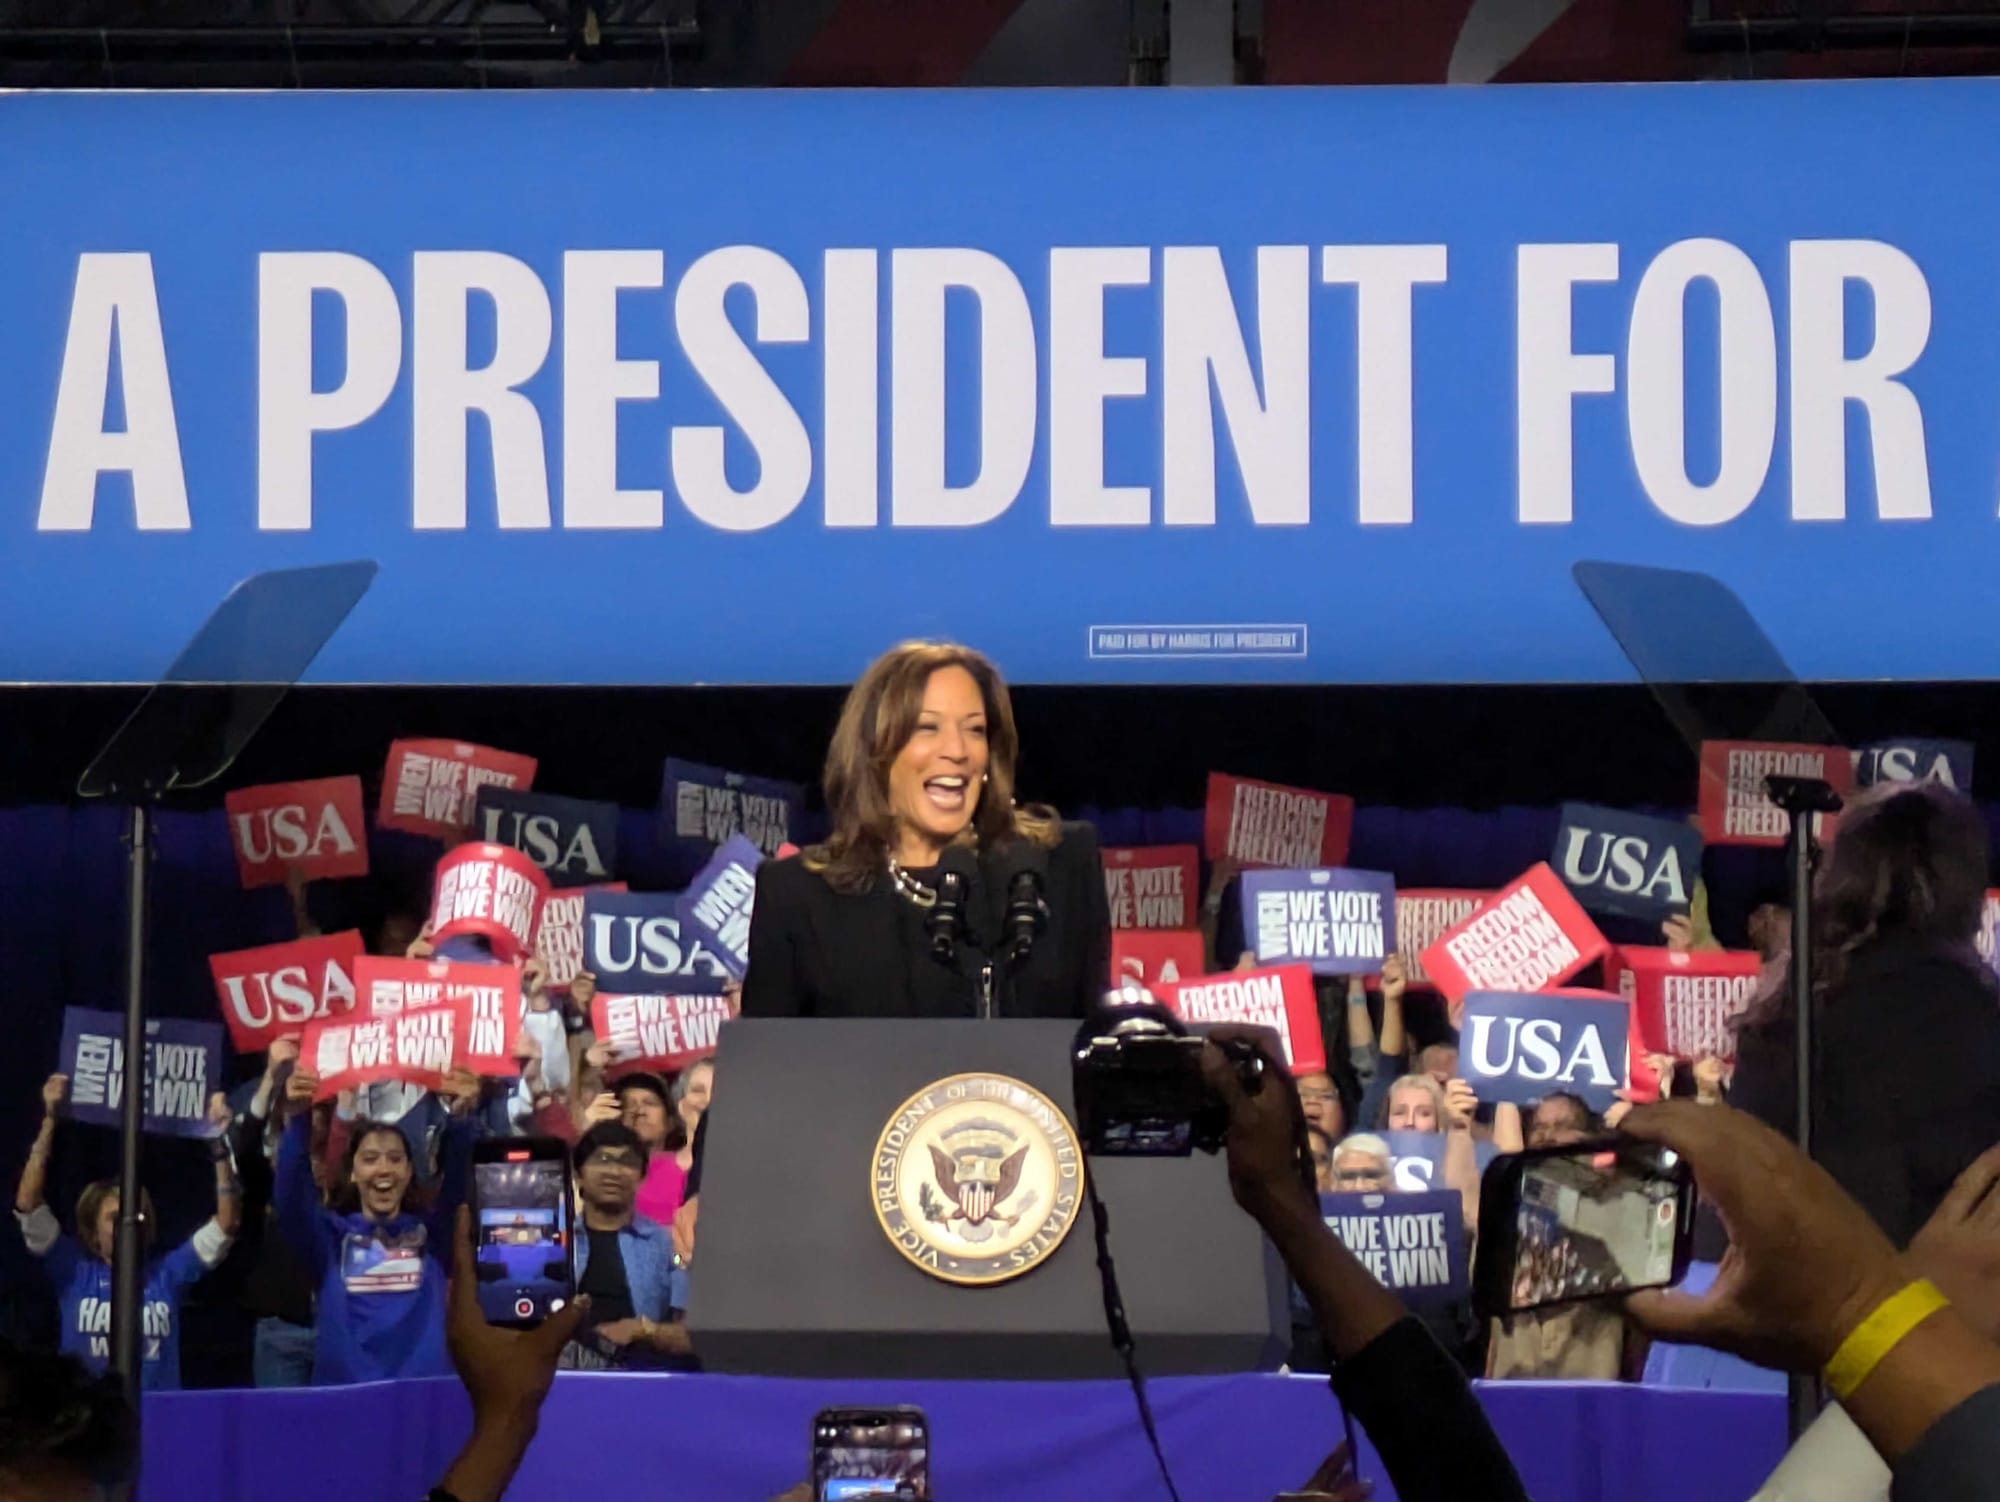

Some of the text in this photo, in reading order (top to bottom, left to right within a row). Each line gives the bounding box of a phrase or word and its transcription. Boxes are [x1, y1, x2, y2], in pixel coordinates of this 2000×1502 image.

[37, 237, 1933, 531] A PRESIDENT FOR
[430, 758, 465, 790] WE
[236, 802, 357, 864] USA
[482, 806, 608, 876] USA
[459, 861, 494, 890] WE
[1131, 866, 1184, 896] VOTE
[1563, 825, 1689, 904] USA
[454, 888, 492, 918] WE
[1135, 895, 1184, 928] WIN
[1288, 890, 1382, 923] WE VOTE
[1289, 922, 1330, 957] WE
[1330, 922, 1384, 958] WIN
[1446, 884, 1542, 965] FREEDOM
[222, 958, 356, 1028] USA
[637, 995, 672, 1023] WE
[1178, 974, 1283, 1021] FREEDOM
[396, 1010, 456, 1039] VOTE
[639, 1019, 682, 1058] WE
[71, 1033, 112, 1104] WHEN
[155, 1043, 208, 1081] VOTE
[351, 1037, 393, 1070] WE
[397, 1034, 454, 1075] WIN
[1470, 1014, 1617, 1086] USA
[154, 1079, 207, 1119] WIN
[879, 1094, 935, 1213] PRESIDENT
[893, 1225, 939, 1268] VICE
[1010, 1193, 1075, 1267] STATES
[1341, 1215, 1382, 1250] WE
[1384, 1212, 1446, 1250] VOTE
[1389, 1246, 1451, 1287] WIN
